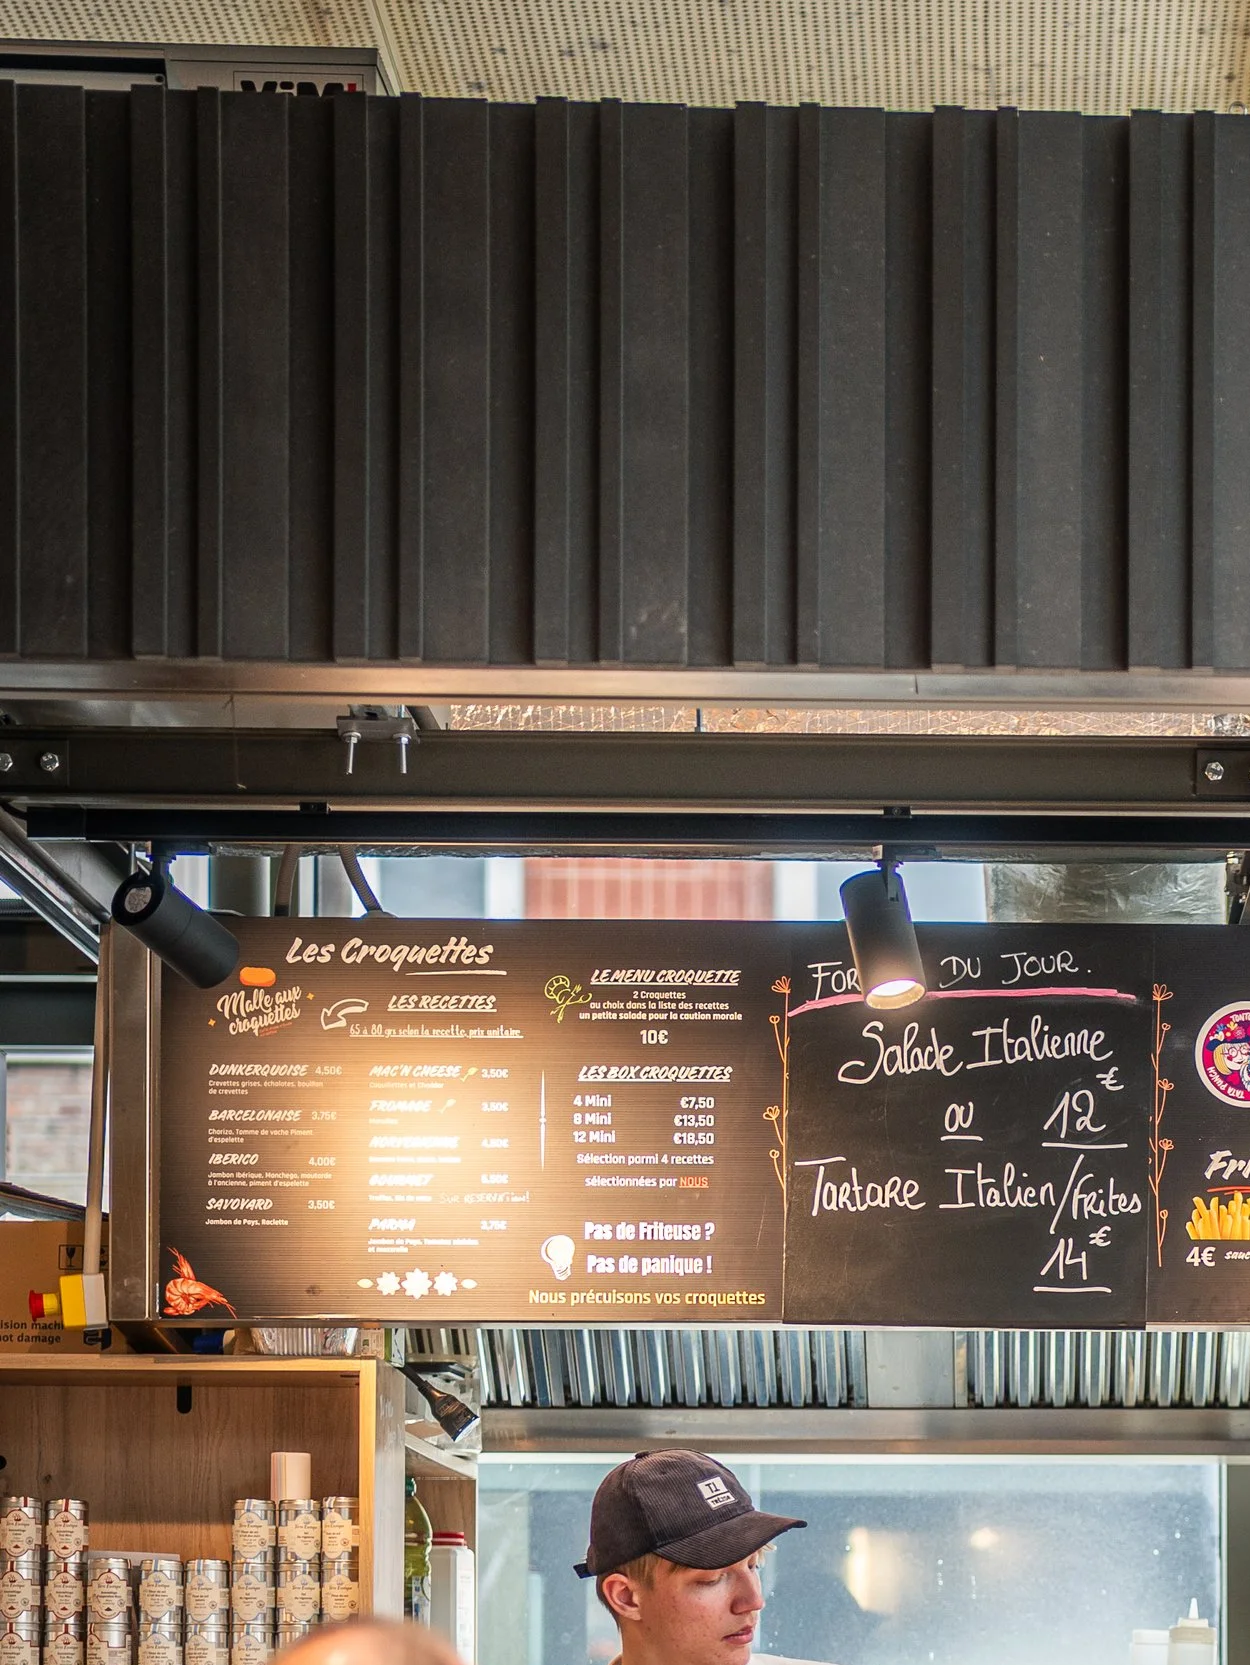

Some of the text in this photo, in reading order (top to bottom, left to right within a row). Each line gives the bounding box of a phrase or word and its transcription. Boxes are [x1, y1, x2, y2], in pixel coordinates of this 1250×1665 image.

[285, 936, 494, 972] Les Croquettes
[591, 969, 741, 984] LE MENU CROQUETTE
[940, 956, 982, 989] DU
[216, 985, 302, 1019] Malle aux
[387, 995, 497, 1010] LES RECETTES
[633, 991, 686, 1000] 2 Croquettes
[602, 1001, 624, 1009] choix
[626, 1001, 646, 1009] dans
[648, 1001, 656, 1009] la
[658, 1001, 676, 1009] liste
[678, 1001, 693, 1009] des
[695, 1002, 729, 1010] recettes
[229, 1003, 301, 1037] croquettes
[592, 1012, 617, 1020] petite
[619, 1012, 647, 1020] salade
[649, 1012, 668, 1021] pour
[670, 1012, 678, 1020] la
[680, 1012, 711, 1020] caution
[713, 1012, 742, 1020] morale
[640, 1030, 668, 1044] 10€
[838, 1014, 1113, 1084] Salade Italienne
[209, 1064, 309, 1076] DUNKERQUOISE
[369, 1064, 410, 1077] MAC'N
[412, 1065, 462, 1078] CHEESE
[578, 1066, 733, 1082] LES BOX CROQUETTES
[1206, 1066, 1245, 1099] TATA PUNCH
[573, 1095, 715, 1109] 4 Mini €7,50
[208, 1110, 302, 1121] BARCELONAISE
[573, 1113, 715, 1127] 8 Mini €13,50
[573, 1131, 715, 1145] 12 Mini €18,50
[208, 1154, 259, 1165] IBERICO
[577, 1153, 714, 1166] Sélection parmi 4 recettes
[585, 1176, 708, 1188] sélectionnées par NOUS
[795, 1156, 926, 1217] Tartare
[206, 1198, 273, 1210] SAVOYARD
[584, 1221, 715, 1240] Pas de Friteuse ?
[1186, 1246, 1216, 1267] 4€
[587, 1255, 712, 1277] Pas de panique !
[529, 1289, 765, 1307] Nous précuisons vos croquettes
[17, 1333, 61, 1344] damage
